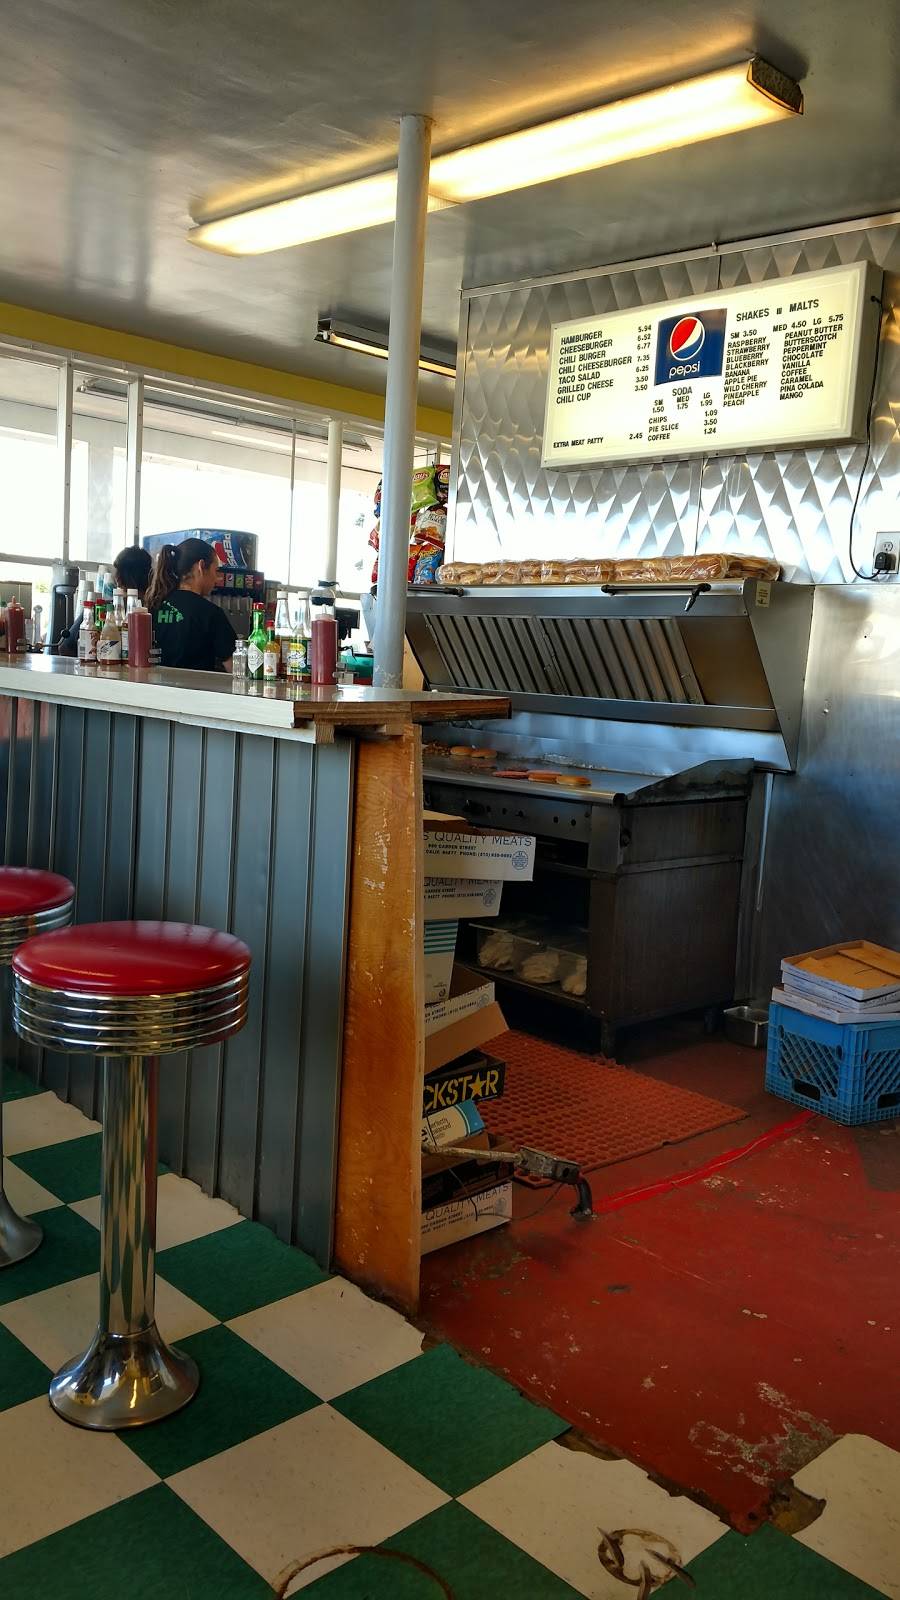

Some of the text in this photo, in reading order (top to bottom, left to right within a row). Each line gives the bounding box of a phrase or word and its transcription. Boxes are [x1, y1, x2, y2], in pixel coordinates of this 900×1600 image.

[736, 308, 770, 322] SHAKES
[789, 299, 819, 312] MALTS
[730, 313, 844, 339] SM 3.50 MED 4.50 LG 5.75
[784, 324, 843, 339] PEANUT BUTTER
[561, 324, 652, 345] HAMBURGER 5.94
[784, 332, 837, 347] BUTTERSCOTCH
[559, 339, 613, 355] CHEESEBURGER
[728, 336, 767, 349] RASPBERRY
[783, 341, 827, 355] PEPPERMINT
[559, 342, 651, 365] CHILI BURGER 6.77
[727, 343, 770, 356] STRAWBERRY
[782, 350, 824, 362] CHOCOLATE
[726, 352, 764, 363] BLUEBERRY
[558, 354, 650, 375] CHILI CHEESEBURGER 7.35
[669, 361, 700, 379] pepsi
[726, 359, 769, 371] BLACKBERRY
[782, 360, 811, 370] VANILLA
[558, 365, 649, 385] TACO SALAD 6.25
[725, 368, 750, 378] BANANA
[781, 367, 807, 377] COFFEE
[557, 375, 649, 395] GRILLED CHEESE 3.50
[724, 376, 745, 385] APPLE
[780, 374, 813, 385] CARAMEL
[672, 386, 693, 397] SODA
[724, 381, 768, 393] WILD CHERRY
[780, 380, 824, 393] PINA COLADA
[556, 394, 575, 404] CHILI
[576, 392, 591, 402] CUP
[676, 395, 689, 403] MED
[723, 389, 760, 400] PINEAPPLE
[780, 391, 803, 400] MANGO
[700, 399, 713, 407] 1.99
[723, 399, 745, 407] PEACH
[648, 409, 718, 424] CHIPS 1.09
[648, 418, 718, 433] PIE SLICE 3.50
[553, 432, 643, 449] EXTRA MEAT PATTY 2.45
[647, 427, 716, 442] COFFEE 1.24
[435, 831, 486, 844] QUALITY
[493, 836, 532, 846] MEATS
